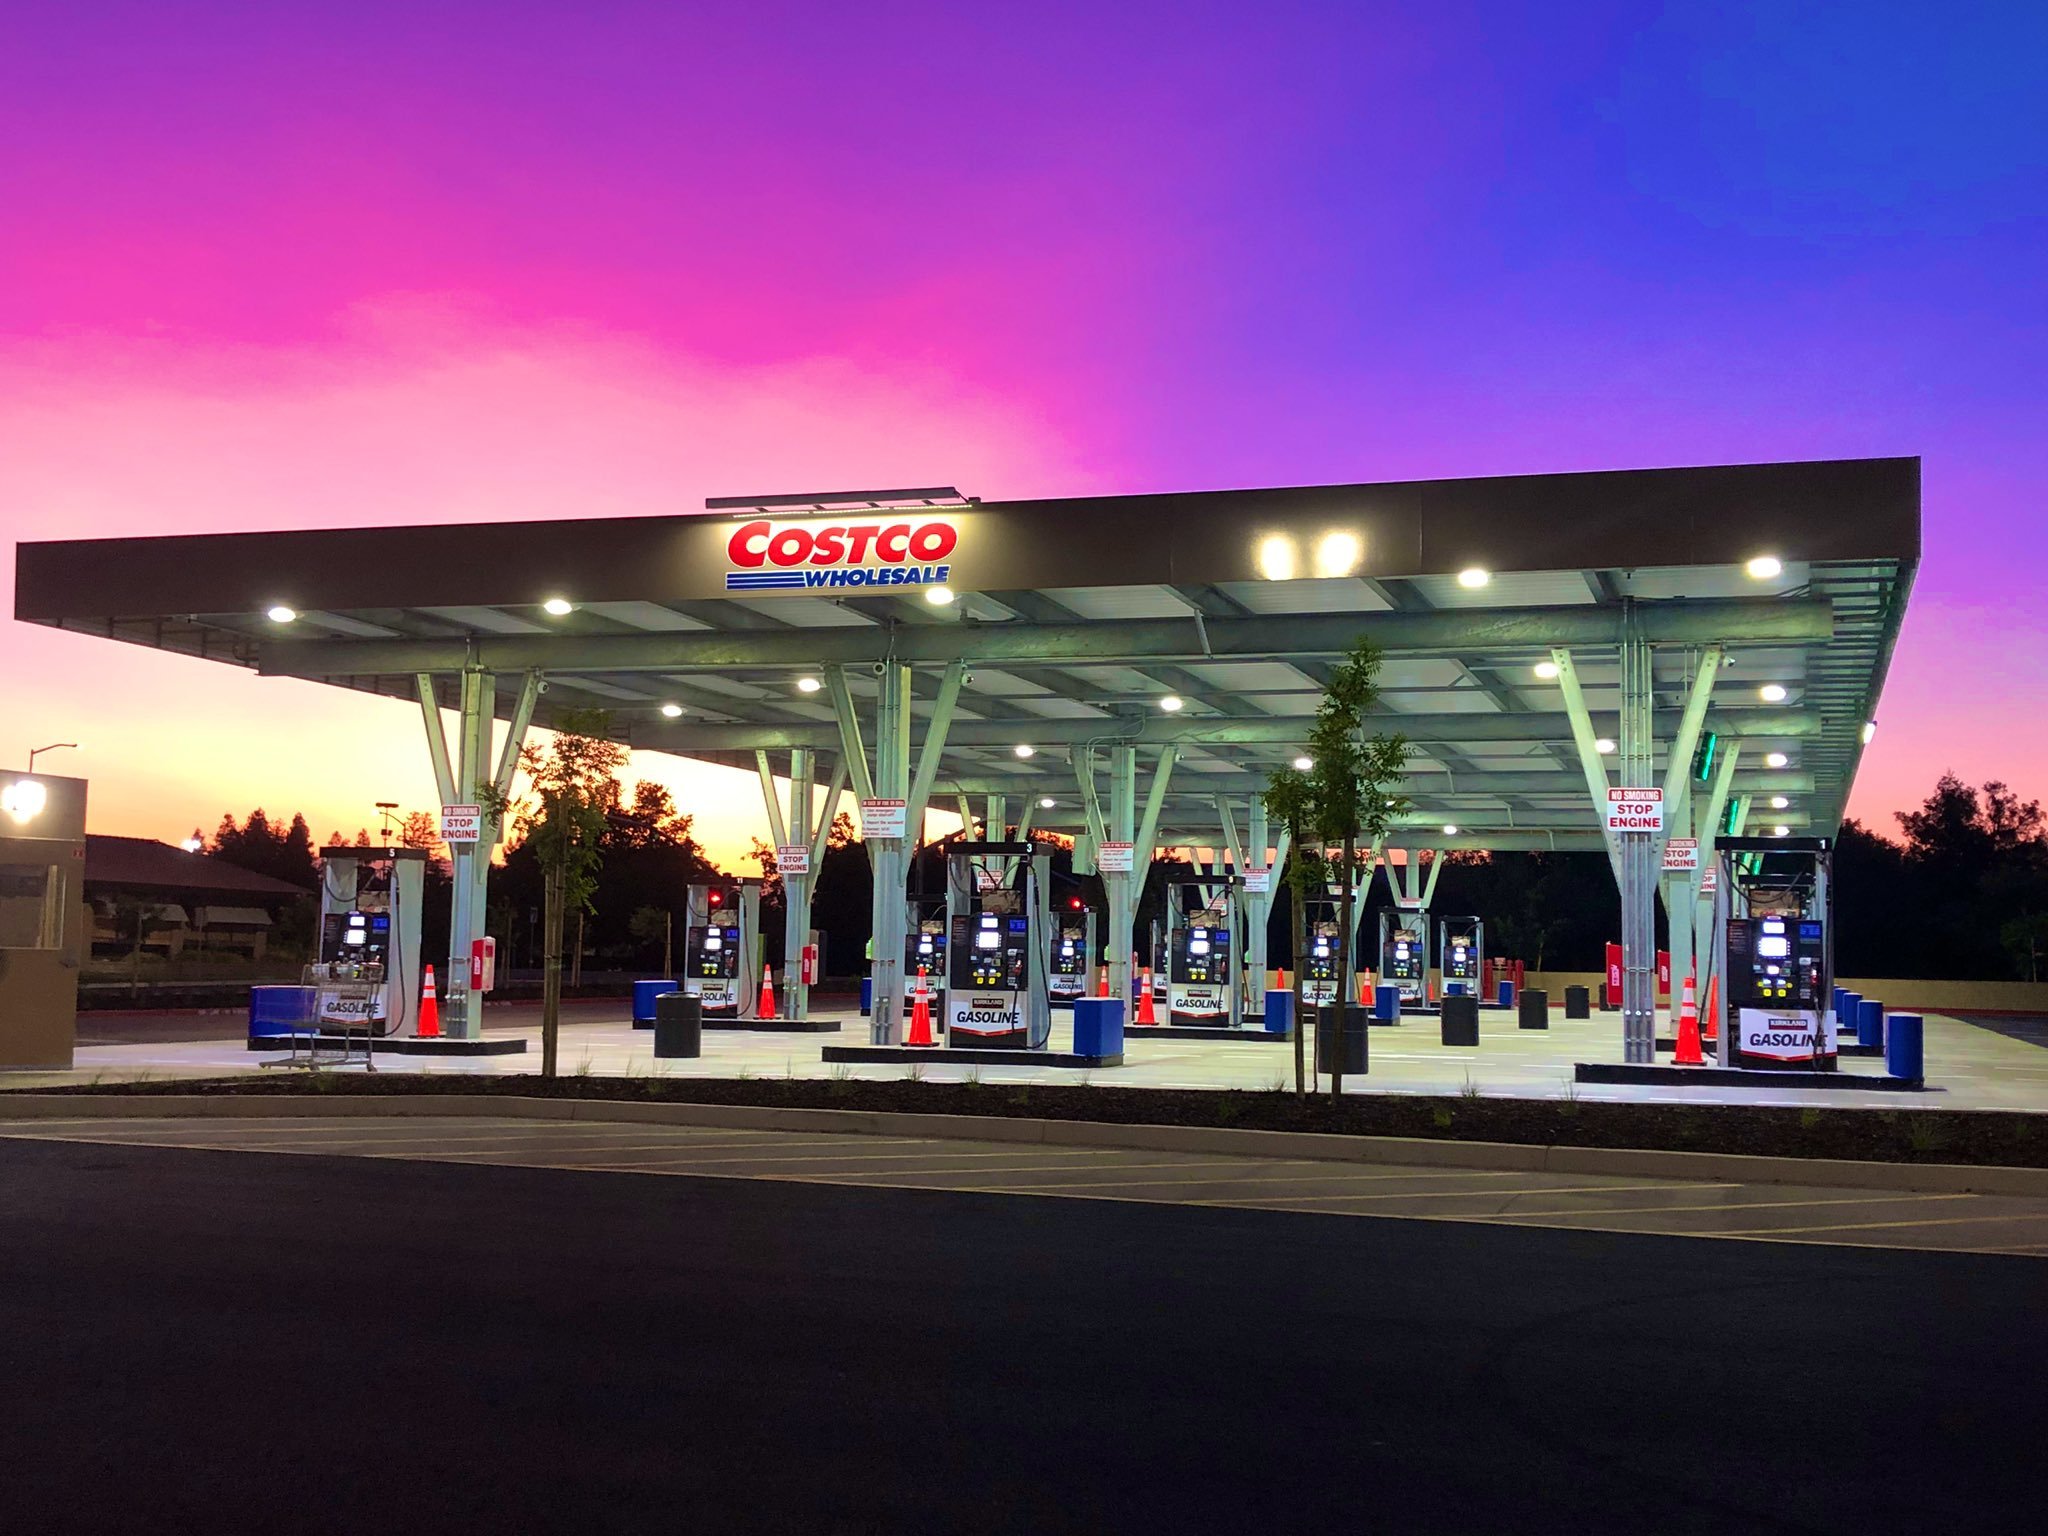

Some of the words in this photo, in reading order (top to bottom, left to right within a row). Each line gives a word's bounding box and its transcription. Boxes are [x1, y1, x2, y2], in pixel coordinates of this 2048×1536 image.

[728, 521, 957, 568] COSTCO
[804, 566, 949, 587] WHOLESALE
[1611, 790, 1622, 800] NO
[1624, 790, 1659, 800] SMOKING
[1617, 804, 1653, 815] STOP
[447, 818, 473, 828] STOP
[1609, 817, 1661, 828] ENGINE
[441, 829, 478, 839] ENGINE
[1026, 843, 1033, 853] 3
[1820, 839, 1826, 849] 1
[389, 848, 395, 857] 5
[1664, 849, 1691, 858] STOP
[782, 855, 804, 863] STOP
[1664, 859, 1697, 867] NGINE
[778, 863, 808, 872] ENGINE
[1303, 992, 1337, 1000] GASOLIN
[1175, 998, 1223, 1009] GASOLINE
[957, 1011, 1020, 1024] GASOLINE
